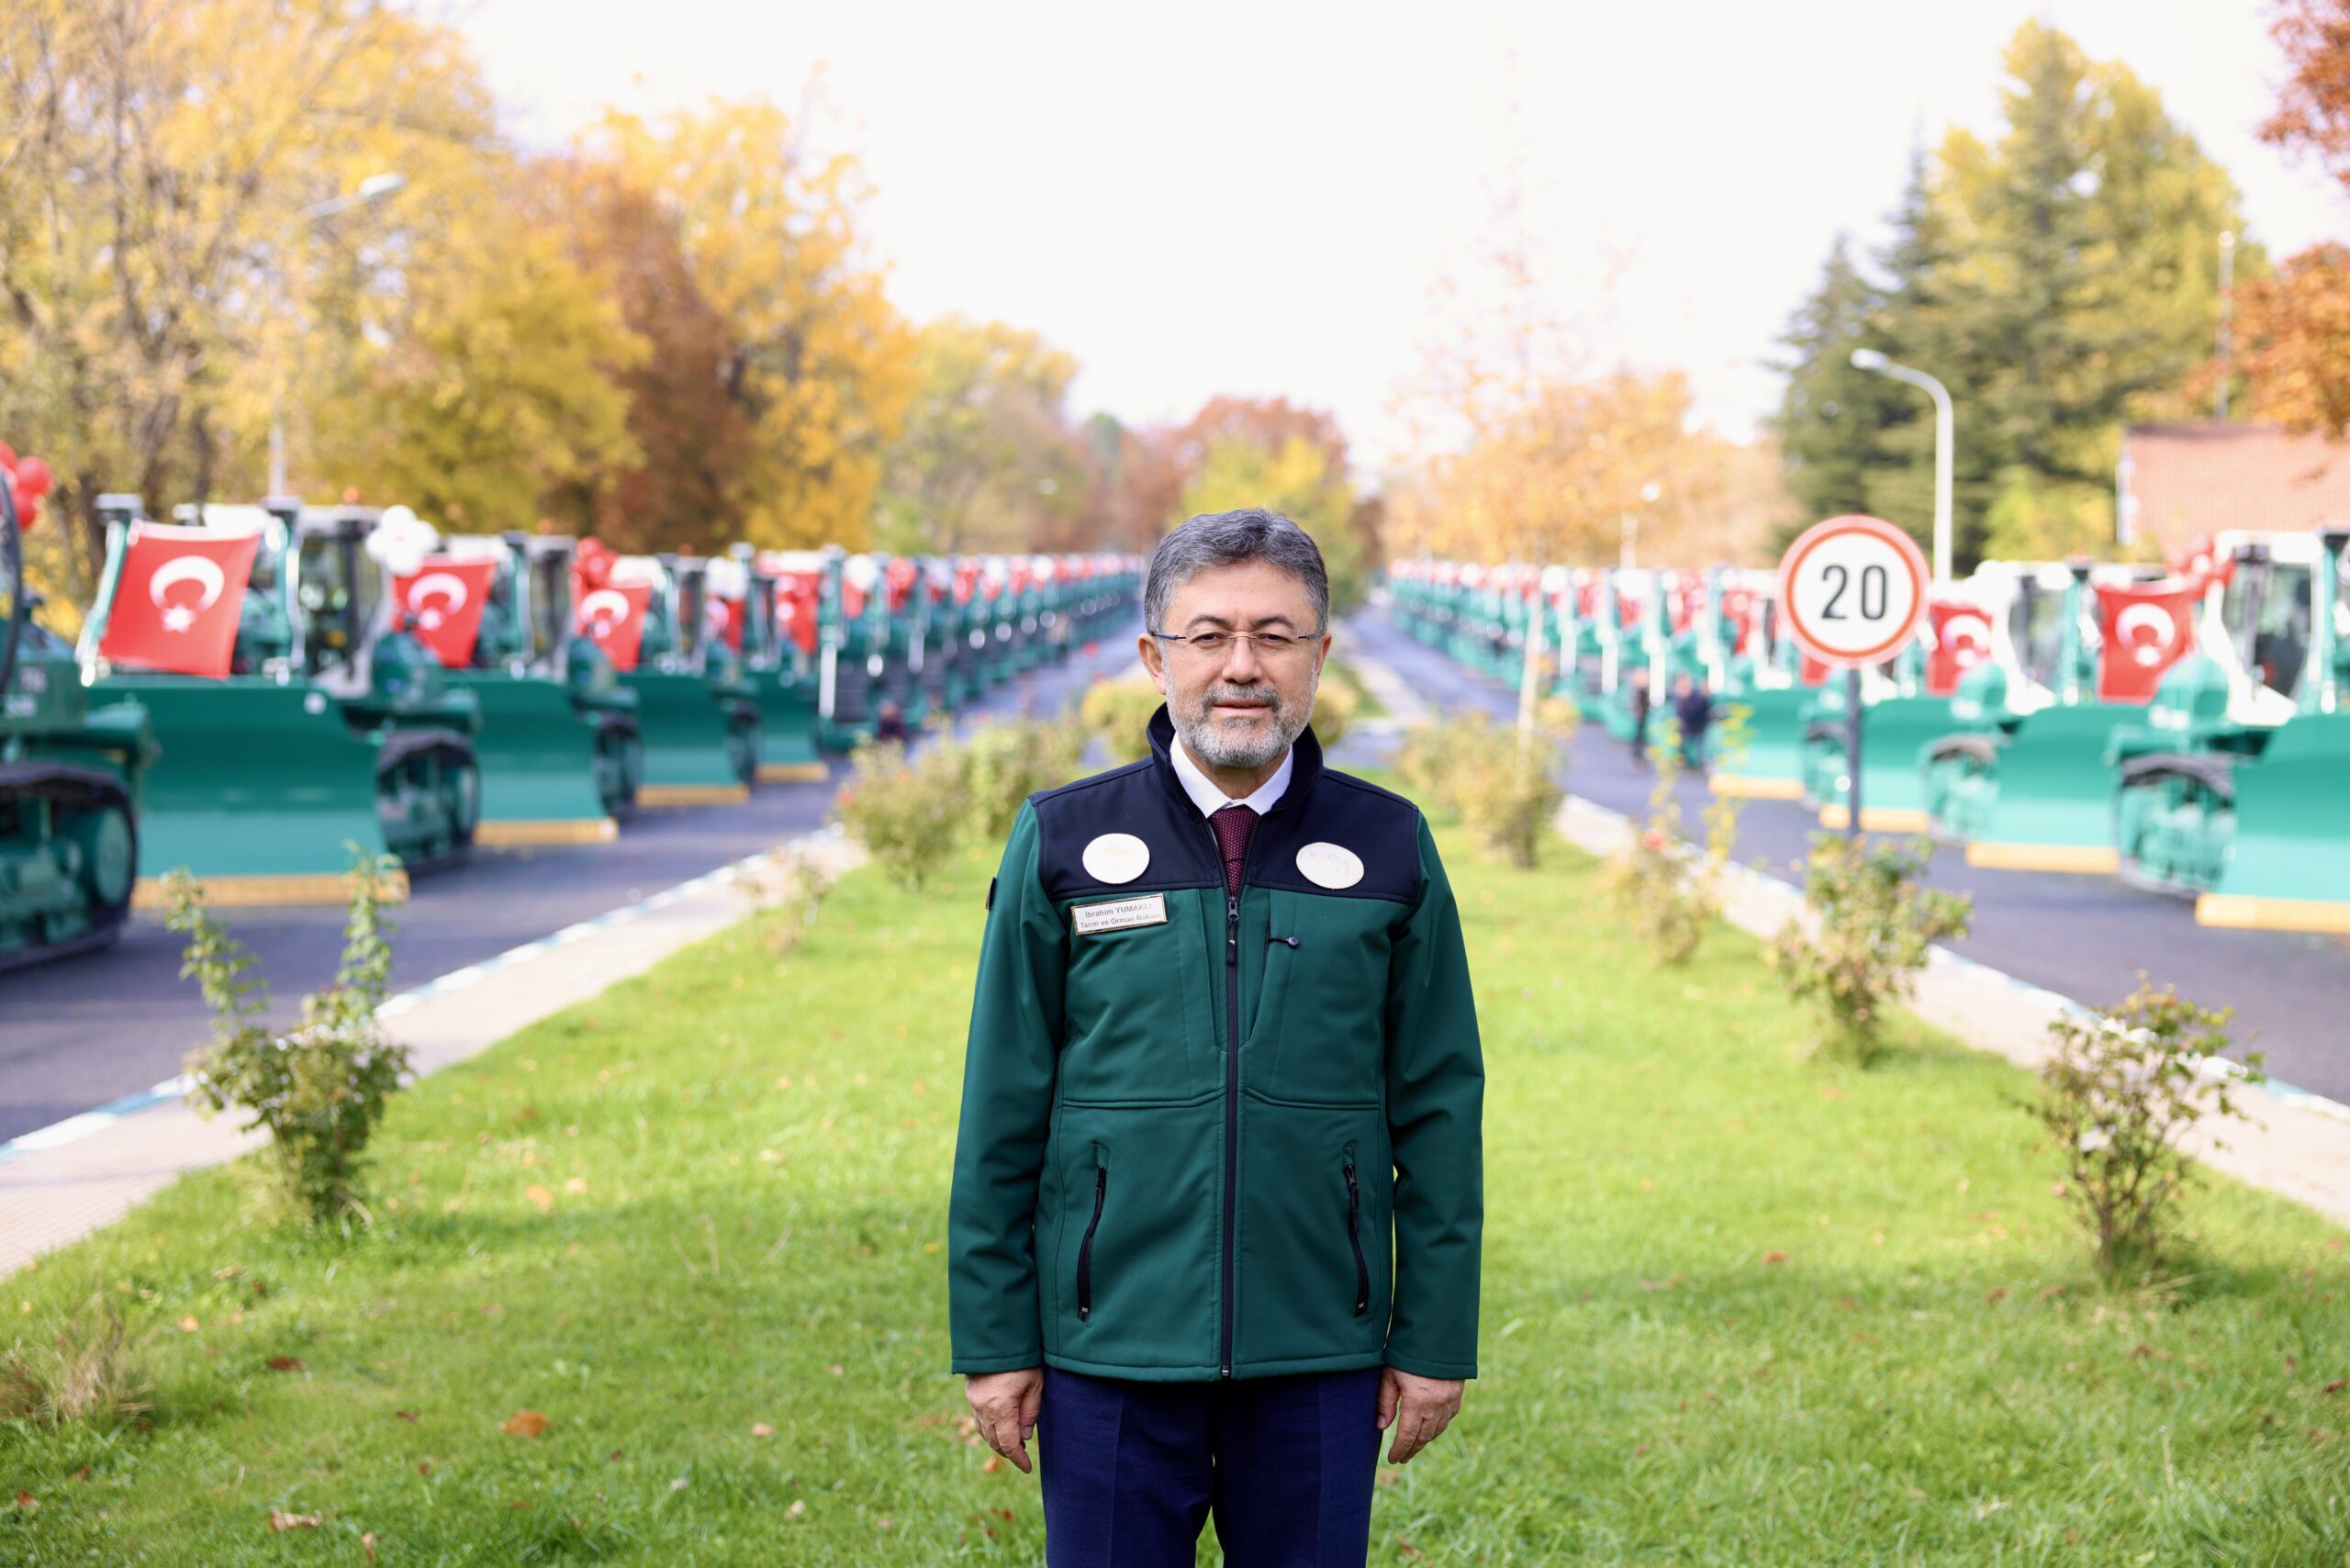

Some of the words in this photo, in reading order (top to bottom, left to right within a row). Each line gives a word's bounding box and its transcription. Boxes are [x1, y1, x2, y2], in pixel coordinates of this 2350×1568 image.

[1821, 565, 1886, 620] 20
[1085, 908, 1113, 918] İbrahim
[1111, 917, 1135, 925] Orman
